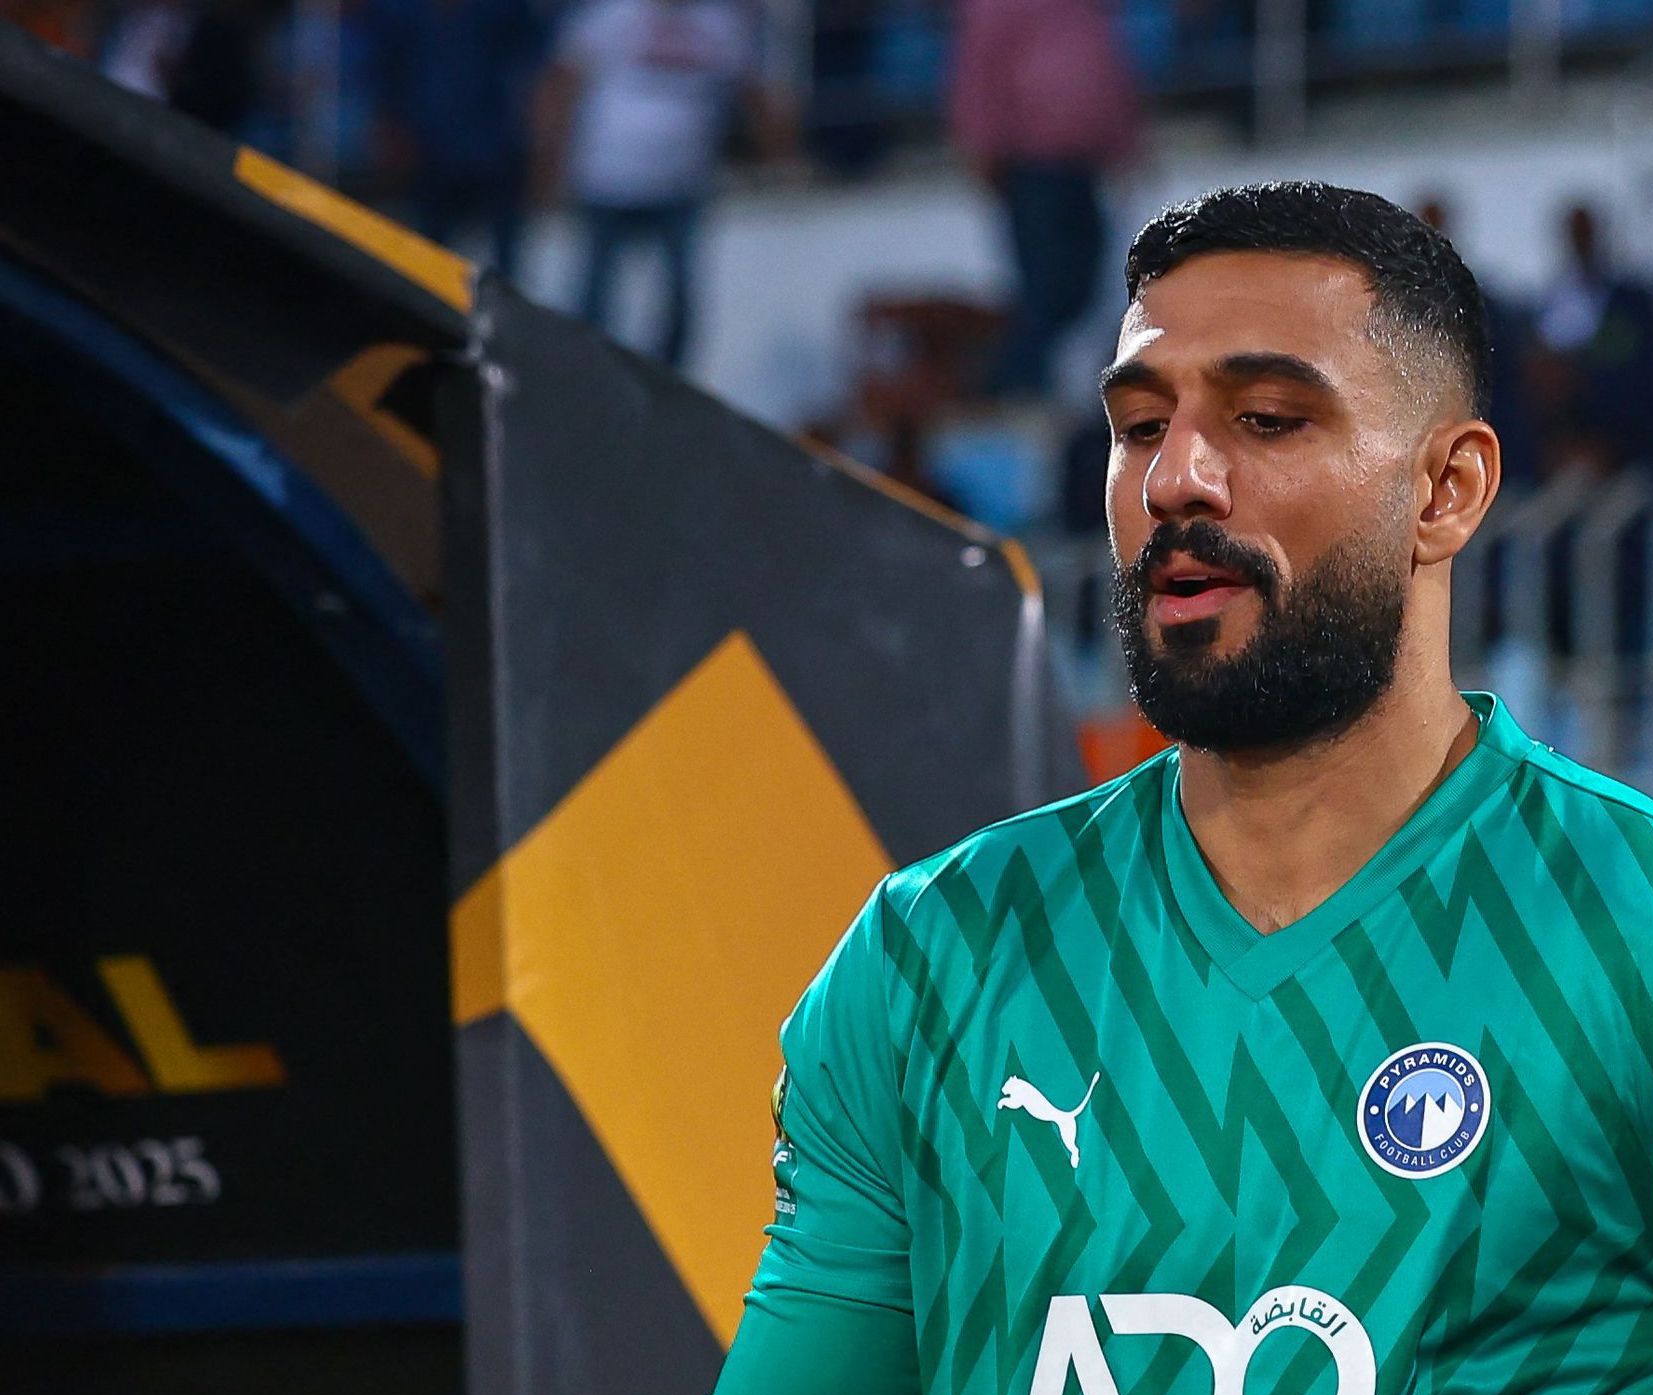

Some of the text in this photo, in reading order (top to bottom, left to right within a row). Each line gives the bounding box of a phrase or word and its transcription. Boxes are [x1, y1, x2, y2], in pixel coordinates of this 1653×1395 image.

[1379, 1052, 1476, 1090] PYRAMIDS
[1374, 1130, 1471, 1167] FOOTBALL CLUB
[57, 1136, 221, 1210] 2025
[1252, 1296, 1348, 1338] القابضة
